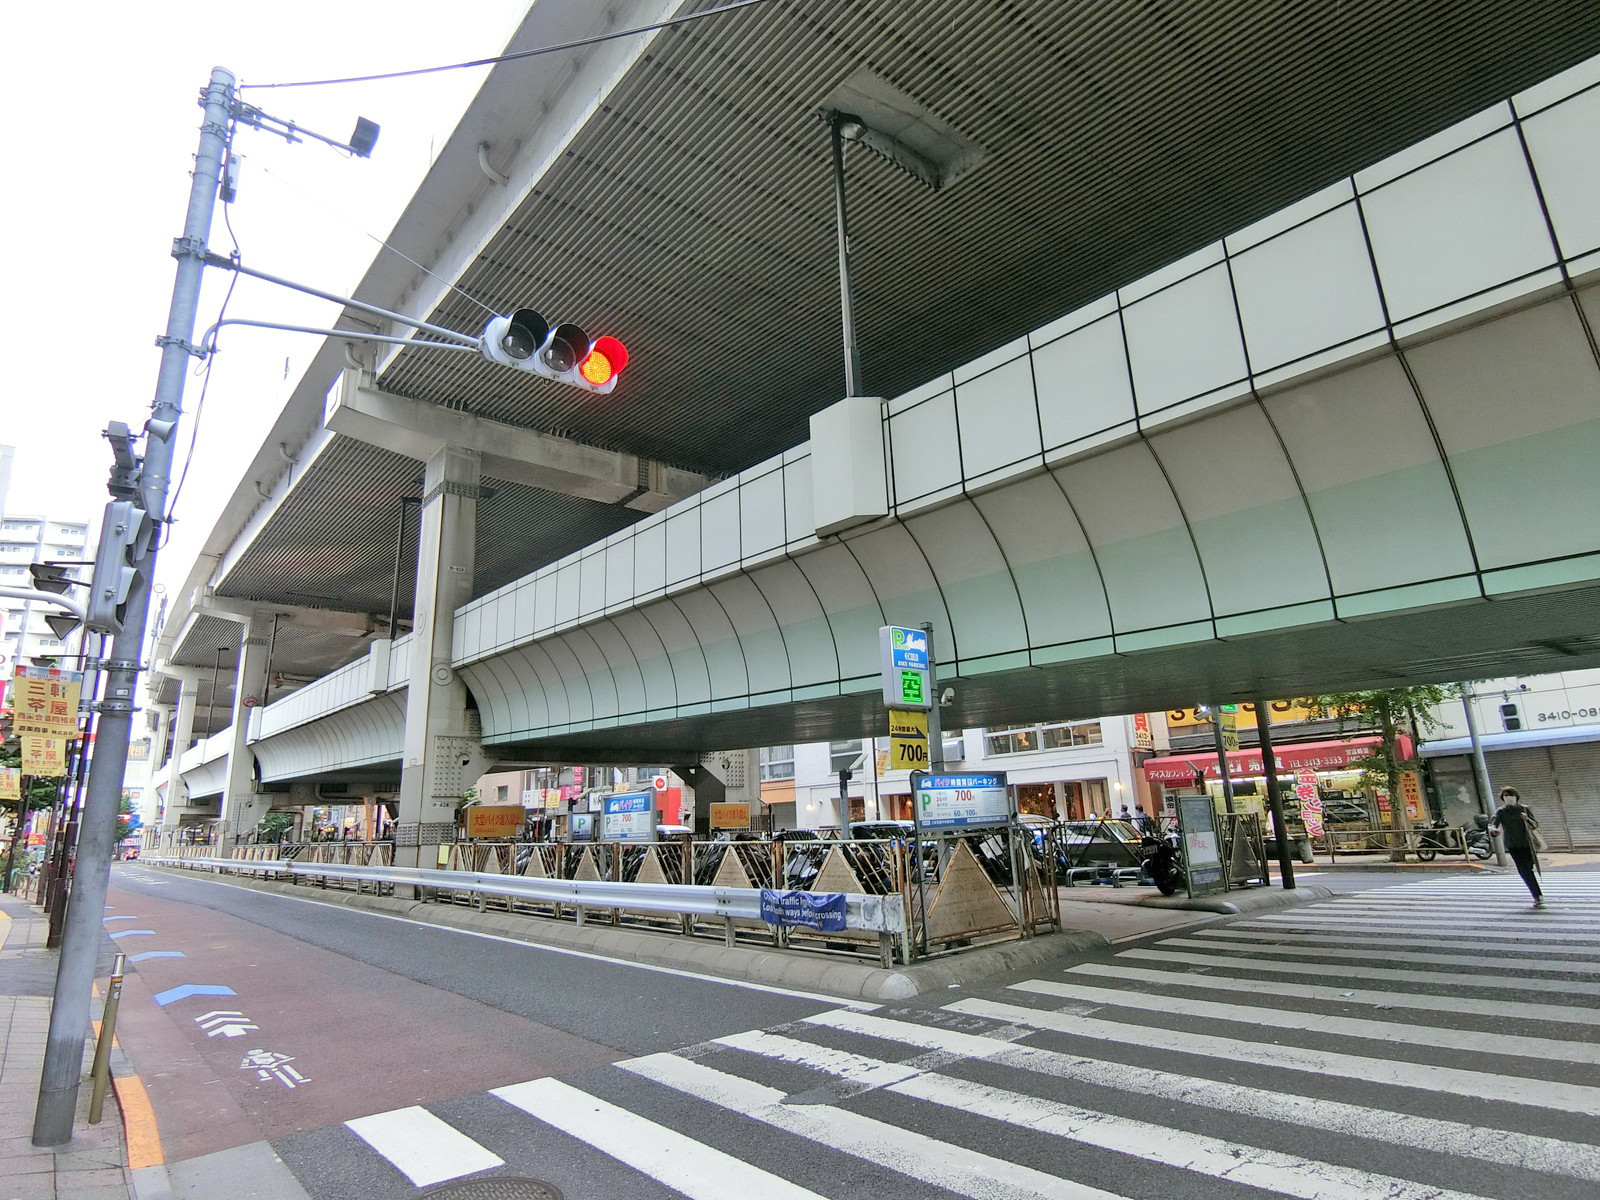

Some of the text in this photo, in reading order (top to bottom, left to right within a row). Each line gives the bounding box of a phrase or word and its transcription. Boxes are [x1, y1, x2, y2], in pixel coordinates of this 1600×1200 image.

[28, 680, 66, 698] 三軒
[27, 698, 68, 716] 茶屋
[1538, 707, 1600, 722] 3410-08
[900, 743, 928, 762] 700円
[1289, 759, 1303, 768] TEL
[1304, 756, 1343, 767] 3413-3333
[921, 793, 932, 811] P
[578, 818, 586, 829] P
[781, 896, 800, 906] traffic
[785, 909, 800, 918] ways
[815, 909, 843, 921] crossing.
